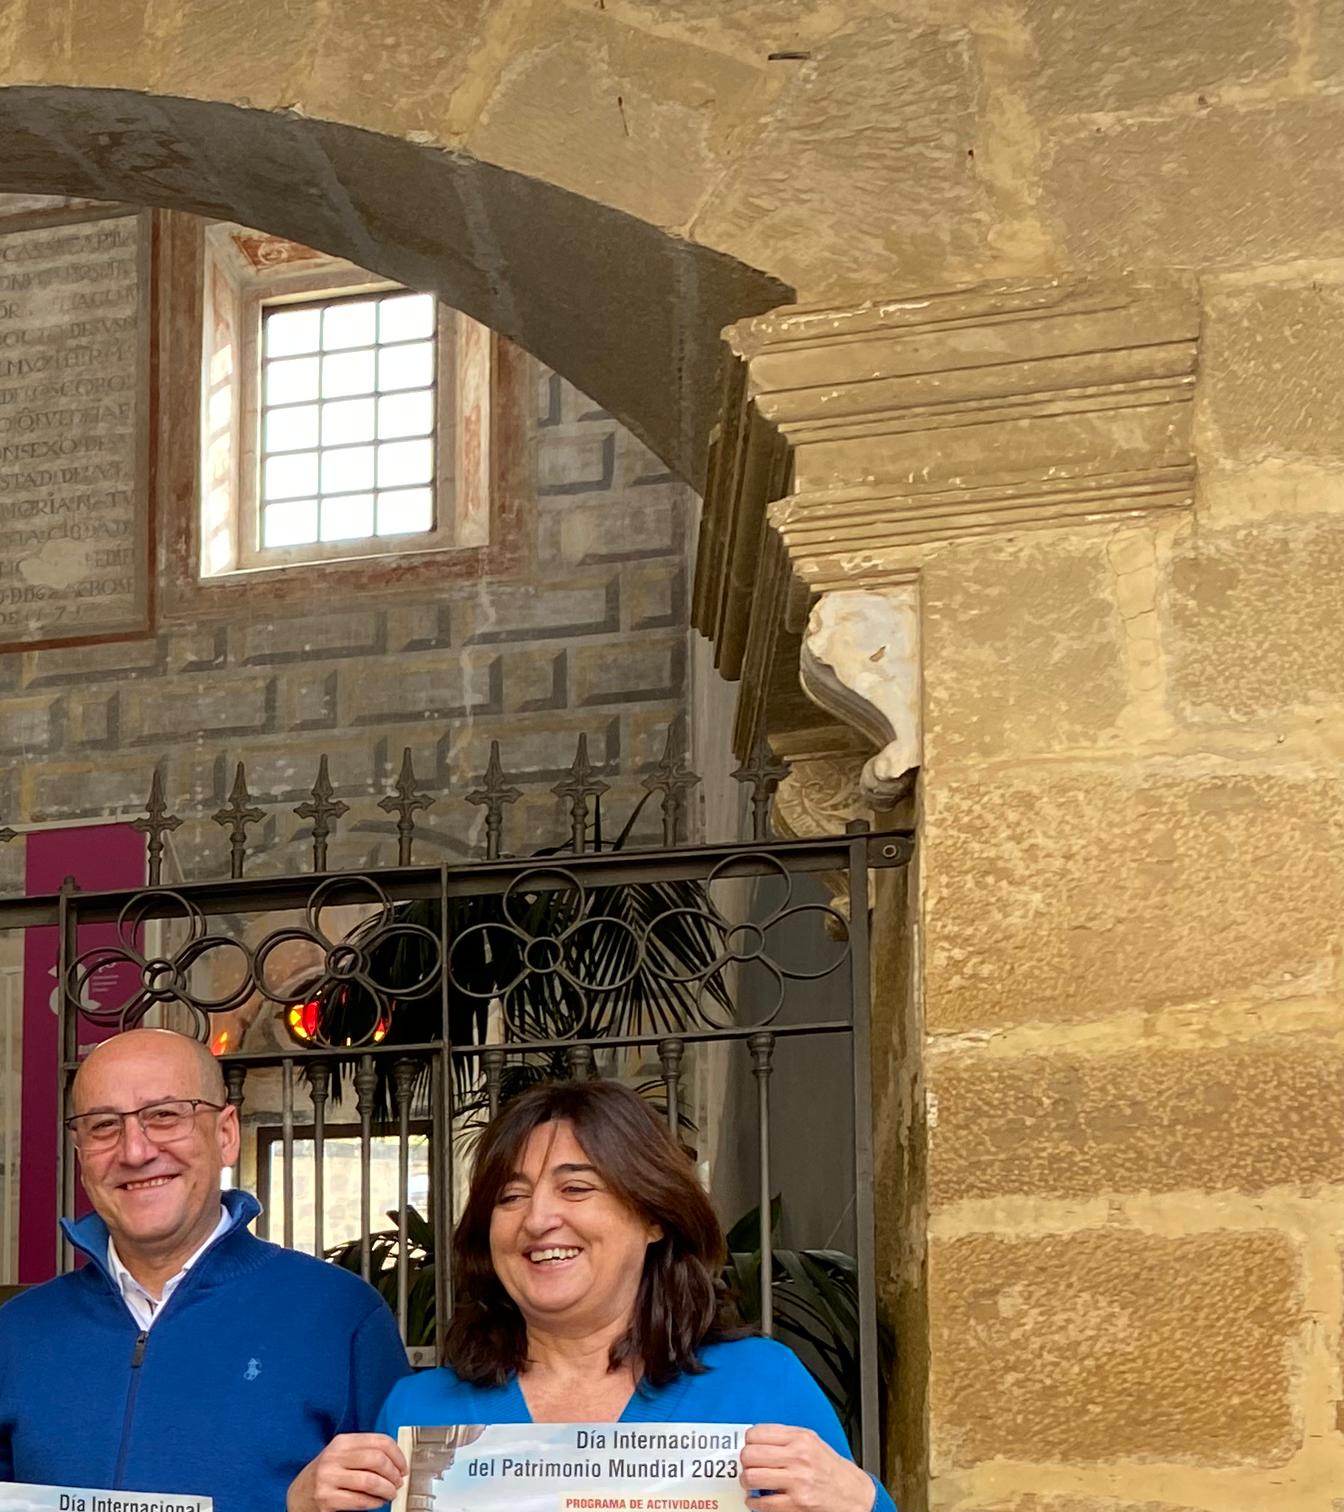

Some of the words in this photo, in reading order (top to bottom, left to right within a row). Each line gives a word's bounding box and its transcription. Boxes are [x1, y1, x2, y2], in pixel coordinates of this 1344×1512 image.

[577, 1431, 606, 1450] Día
[614, 1431, 738, 1450] Internacional
[468, 1459, 495, 1477] del
[502, 1459, 601, 1478] Patrimonio
[609, 1459, 684, 1478] Mundial
[692, 1460, 738, 1478] 2023
[60, 1494, 85, 1512] Día
[566, 1498, 626, 1509] PROGRAMA
[630, 1499, 643, 1509] DE
[647, 1499, 719, 1510] ACTIVIDADES
